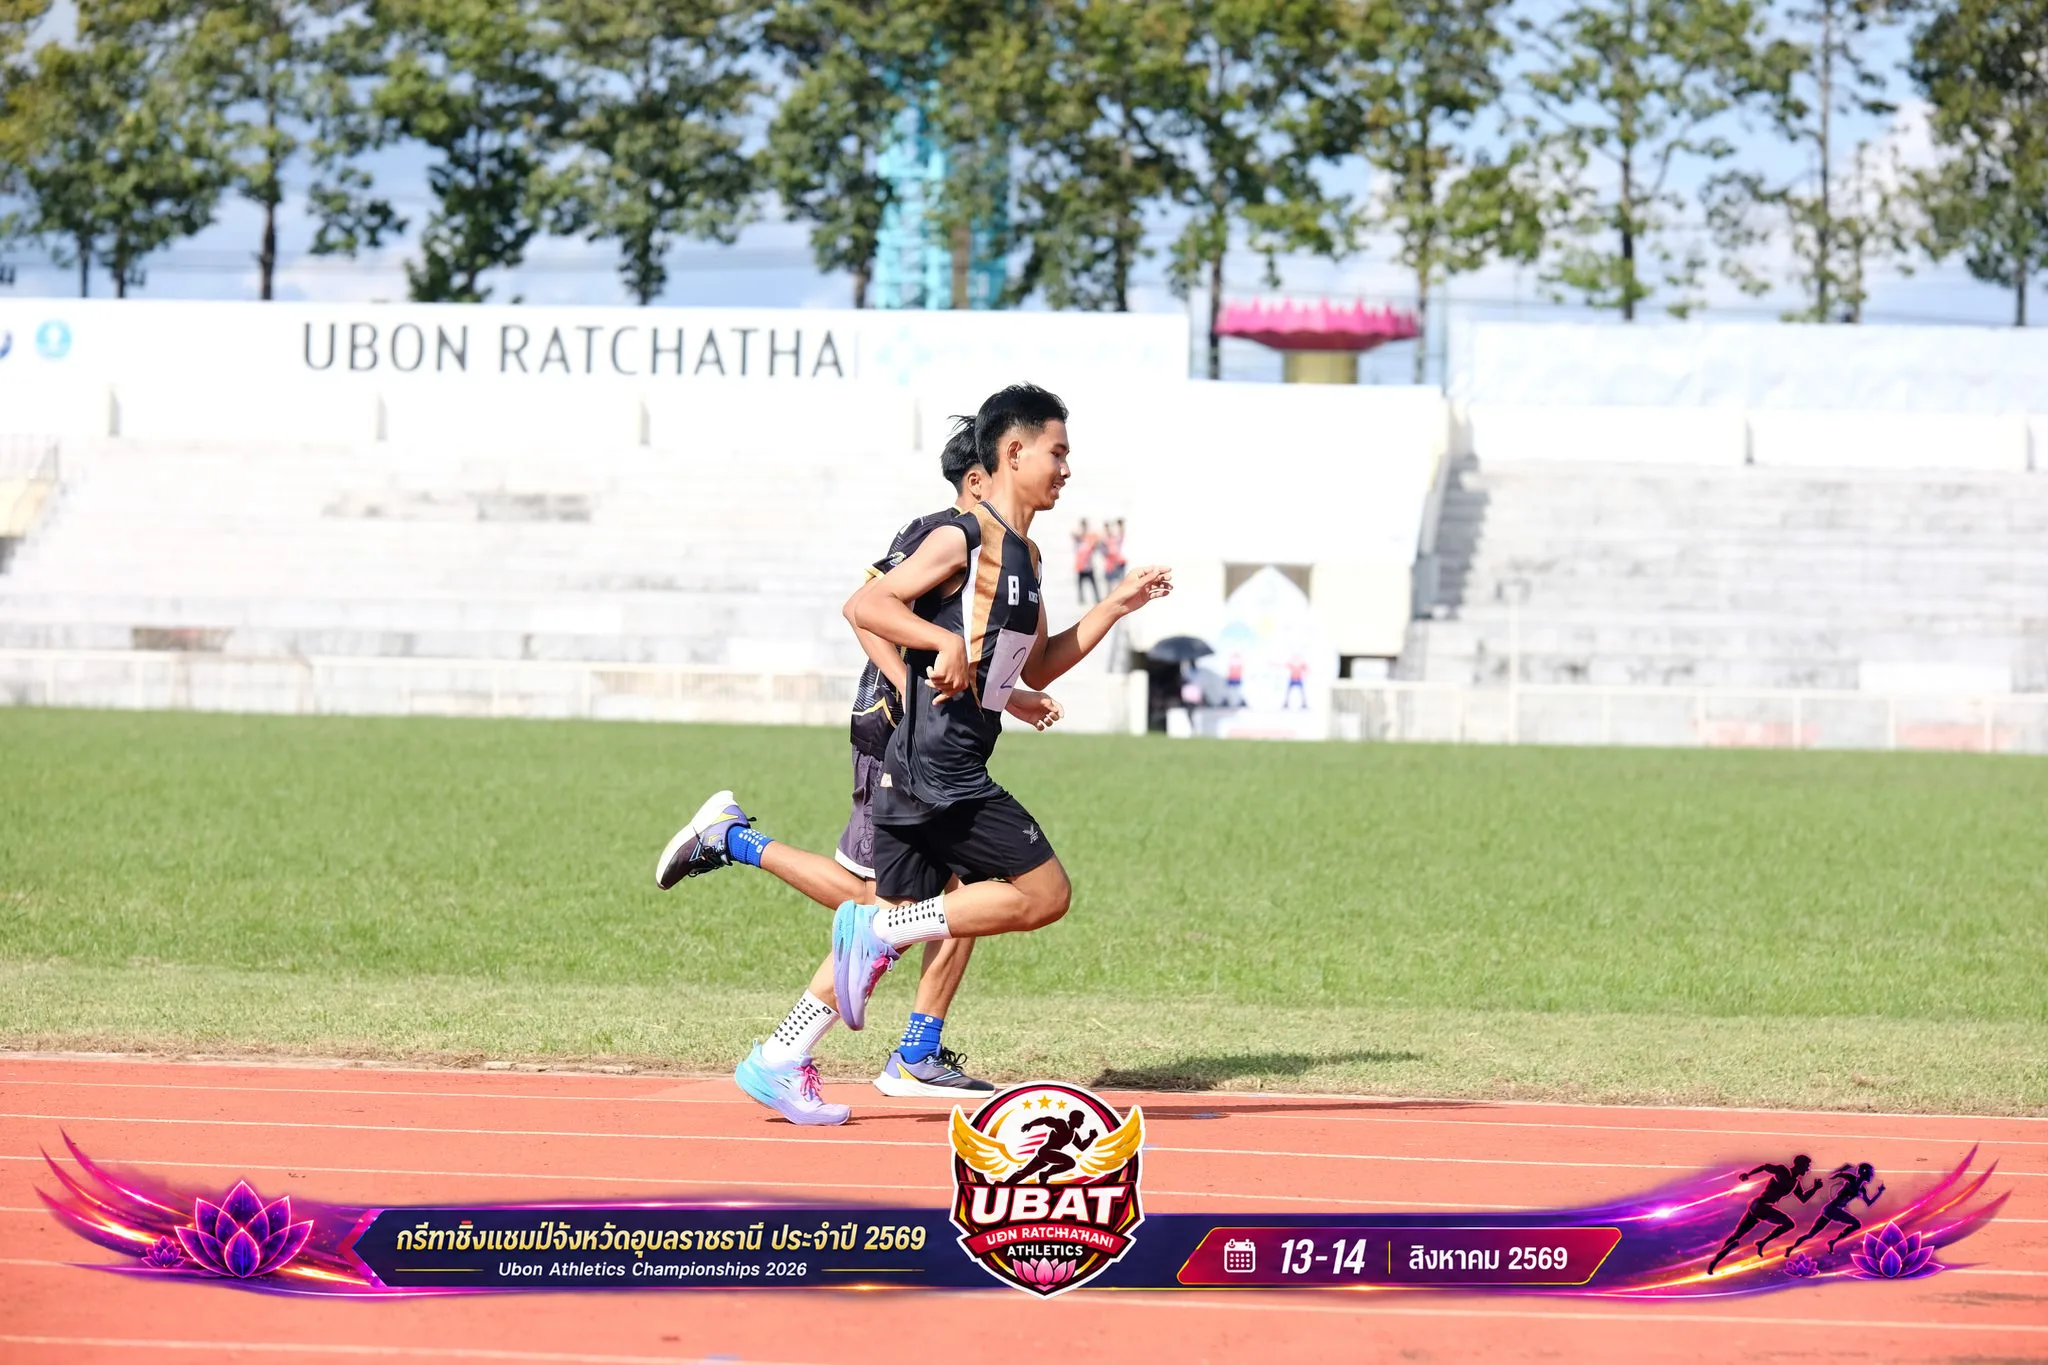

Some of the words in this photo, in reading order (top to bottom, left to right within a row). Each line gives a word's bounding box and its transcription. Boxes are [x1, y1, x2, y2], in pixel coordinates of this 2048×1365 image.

[304, 323, 467, 371] UBON
[500, 326, 843, 377] RATCHATHA
[1000, 646, 1027, 689] 2
